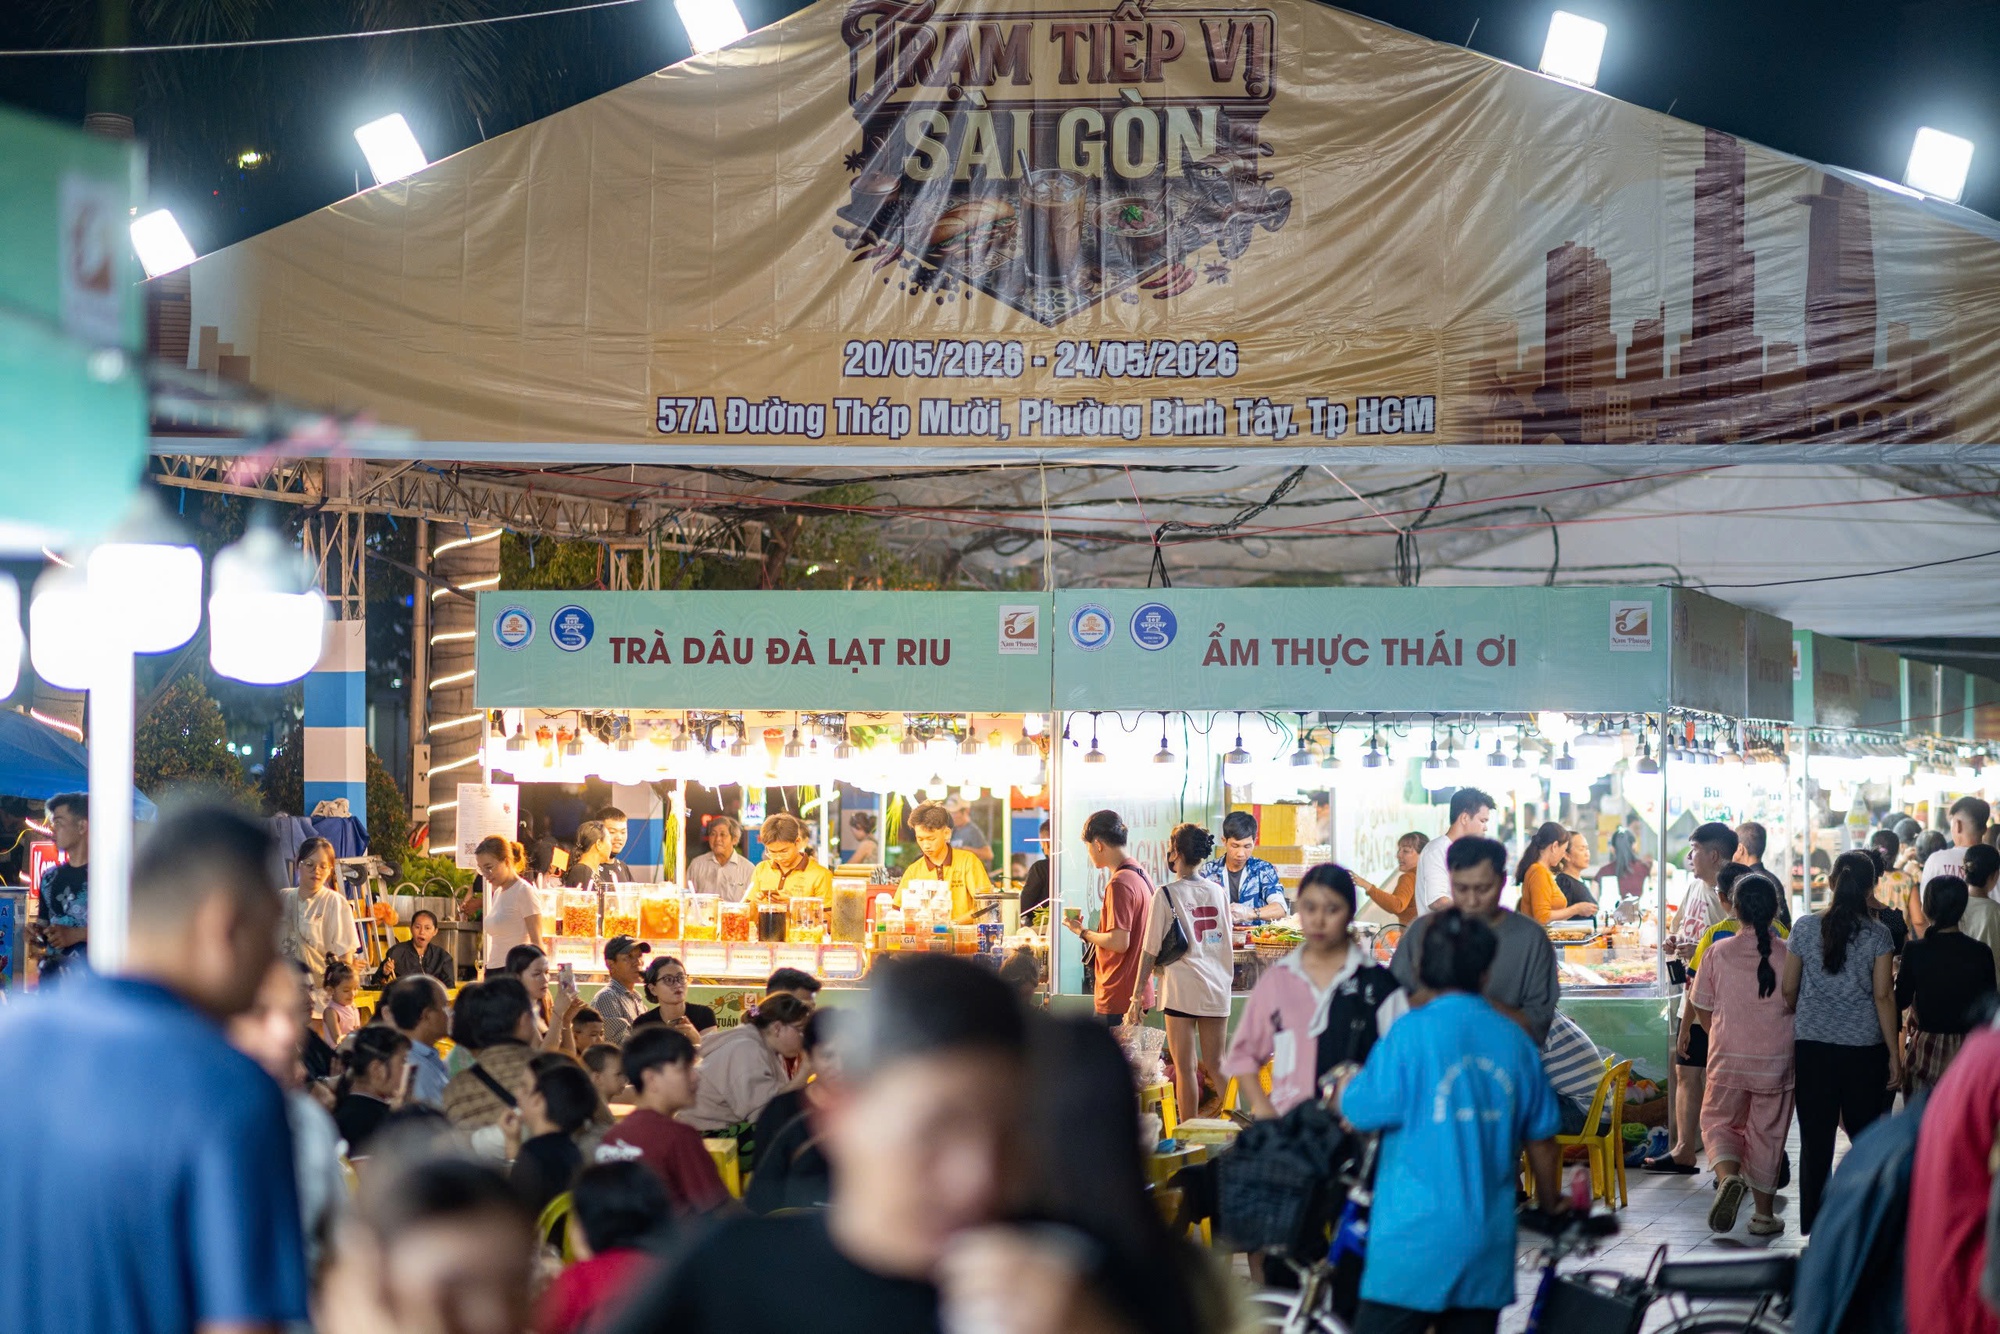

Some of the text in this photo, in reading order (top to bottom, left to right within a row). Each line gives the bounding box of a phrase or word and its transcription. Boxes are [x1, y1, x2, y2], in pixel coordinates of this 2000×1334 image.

[841, 0, 1268, 100] TRẠM TIẾP VỊ
[902, 88, 1225, 181] SÀI GÒN
[843, 339, 1239, 379] 20/05/2026 - 24/05/2026
[655, 394, 1437, 441] 57A Đường Tháp Mười, Phường Bình Tây. Tp HCM
[608, 628, 952, 674] TRÀ DÂU ĐÀ LẠT RIU
[1202, 622, 1516, 675] ẨM THỰC THÁI ƠI
[1943, 864, 1966, 879] VAN
